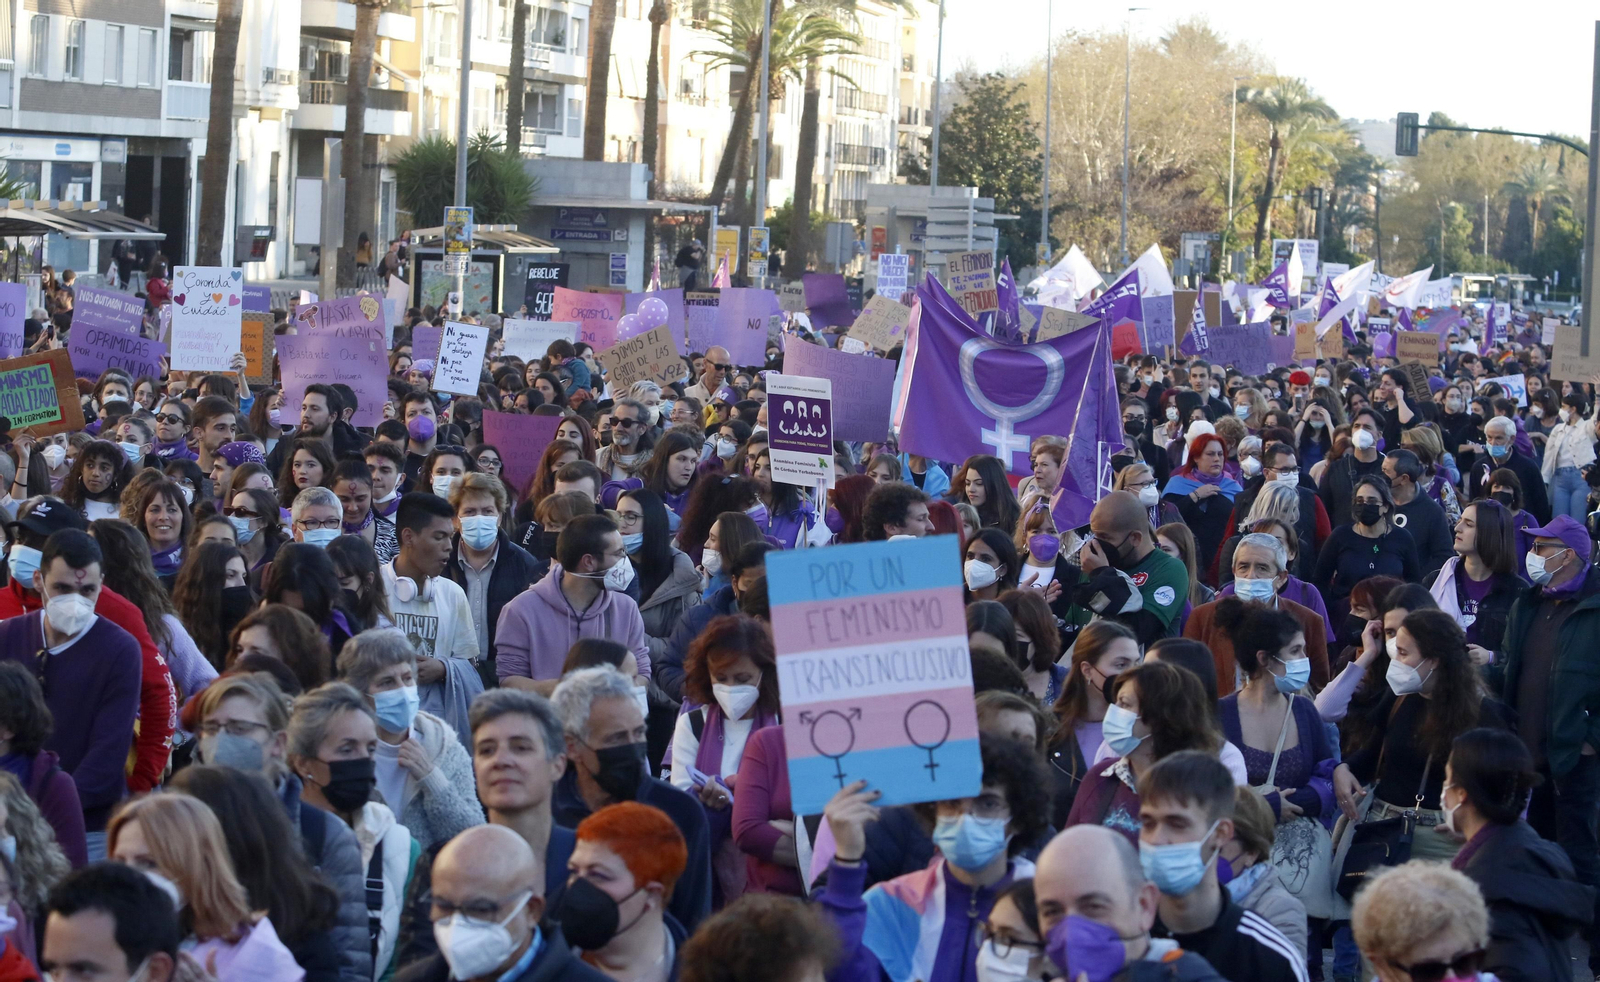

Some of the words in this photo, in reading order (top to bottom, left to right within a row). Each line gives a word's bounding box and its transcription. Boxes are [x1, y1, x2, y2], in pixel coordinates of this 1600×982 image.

[529, 268, 560, 279] REBELDE
[950, 261, 960, 272] EL
[79, 290, 94, 303] NOS
[94, 294, 123, 311] QUITARON
[124, 302, 143, 315] TANTO
[321, 303, 356, 329] HASTA
[747, 318, 761, 329] NO
[446, 327, 456, 336] Ni
[86, 330, 149, 358] OPRIMIDAS
[611, 337, 644, 364] SOMOS
[1401, 337, 1437, 346] FEMINISMO
[74, 346, 90, 356] POR
[441, 356, 449, 365] Ni
[614, 361, 635, 380] GRITO
[637, 355, 649, 366] DE
[656, 345, 669, 359] LAS
[650, 363, 660, 373] NO
[808, 560, 856, 598] POR
[868, 556, 905, 589] UN
[805, 597, 944, 644] FEMINISMO
[787, 645, 968, 698] TRANSINCLUSIVO
